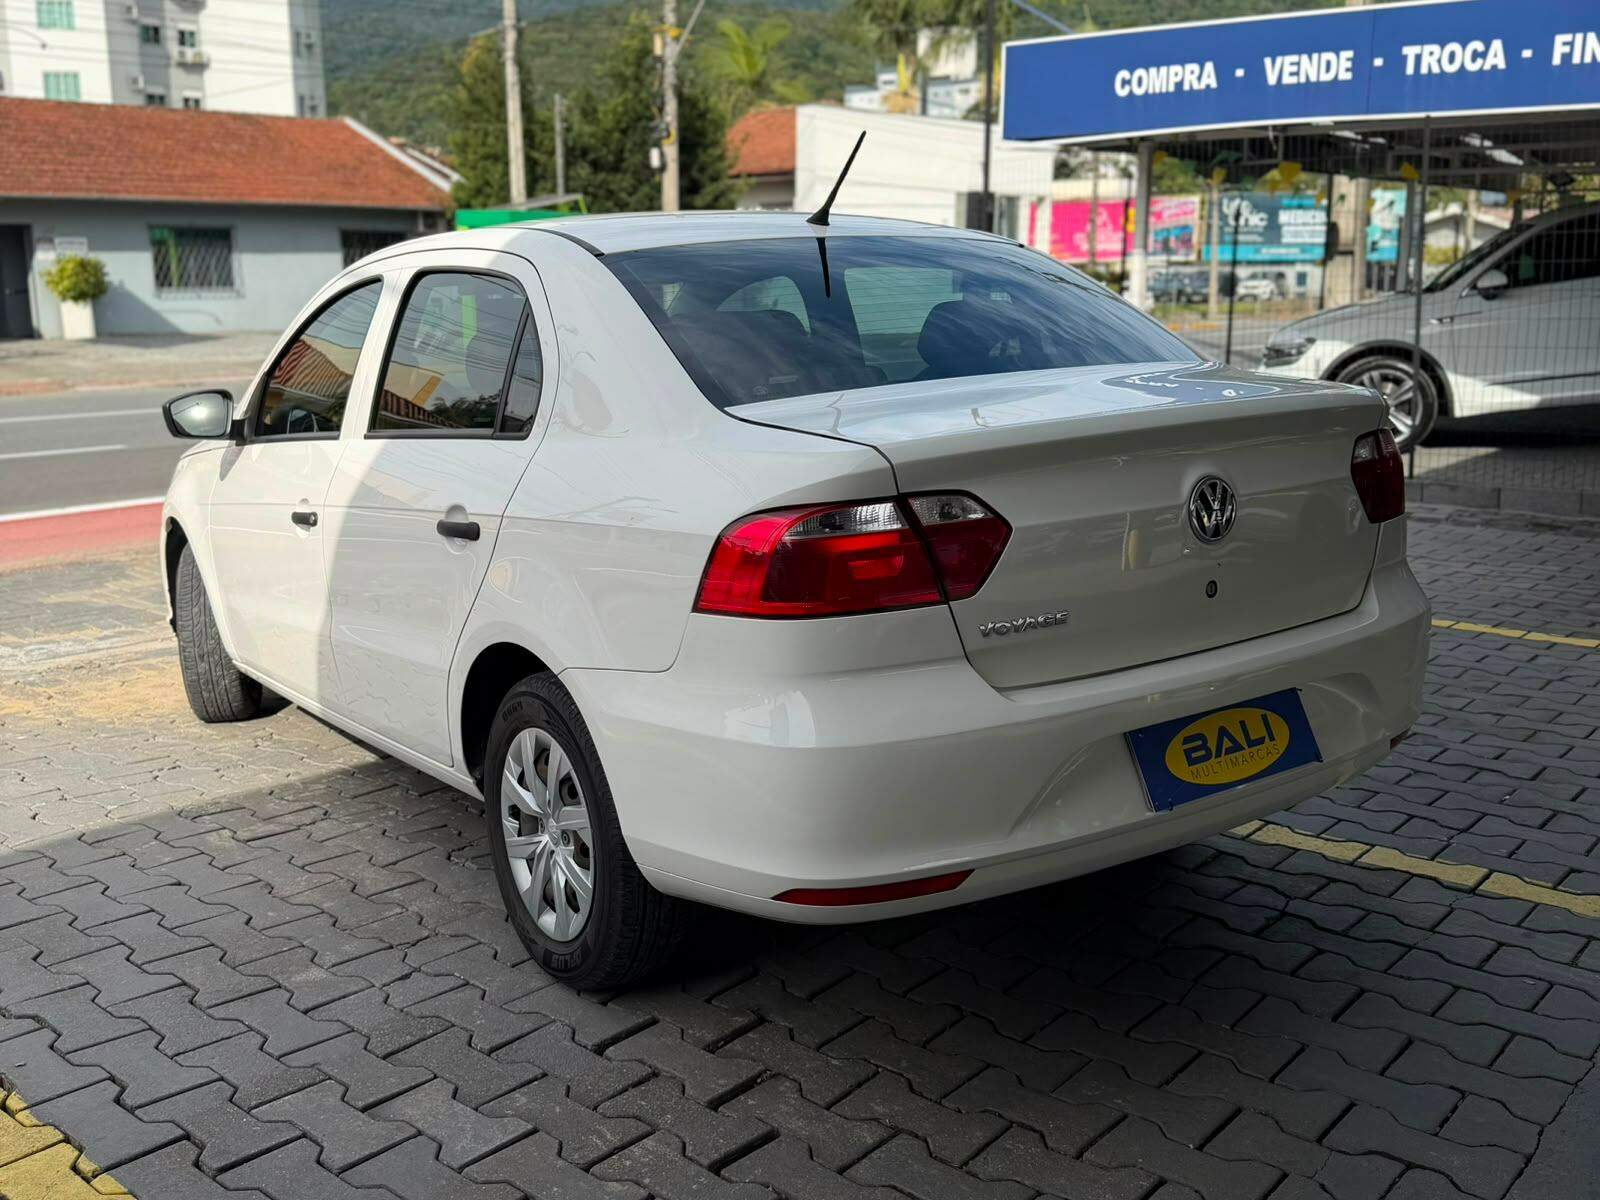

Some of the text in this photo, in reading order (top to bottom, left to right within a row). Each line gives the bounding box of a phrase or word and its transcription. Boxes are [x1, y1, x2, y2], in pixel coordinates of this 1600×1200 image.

[1114, 61, 1218, 97] COMPRA
[1264, 50, 1354, 86] VENDE
[1402, 39, 1506, 75] TROCA
[979, 609, 1070, 638] VOYAGE
[1182, 713, 1275, 767] BALI
[1190, 743, 1280, 781] MULTIMARCAS
